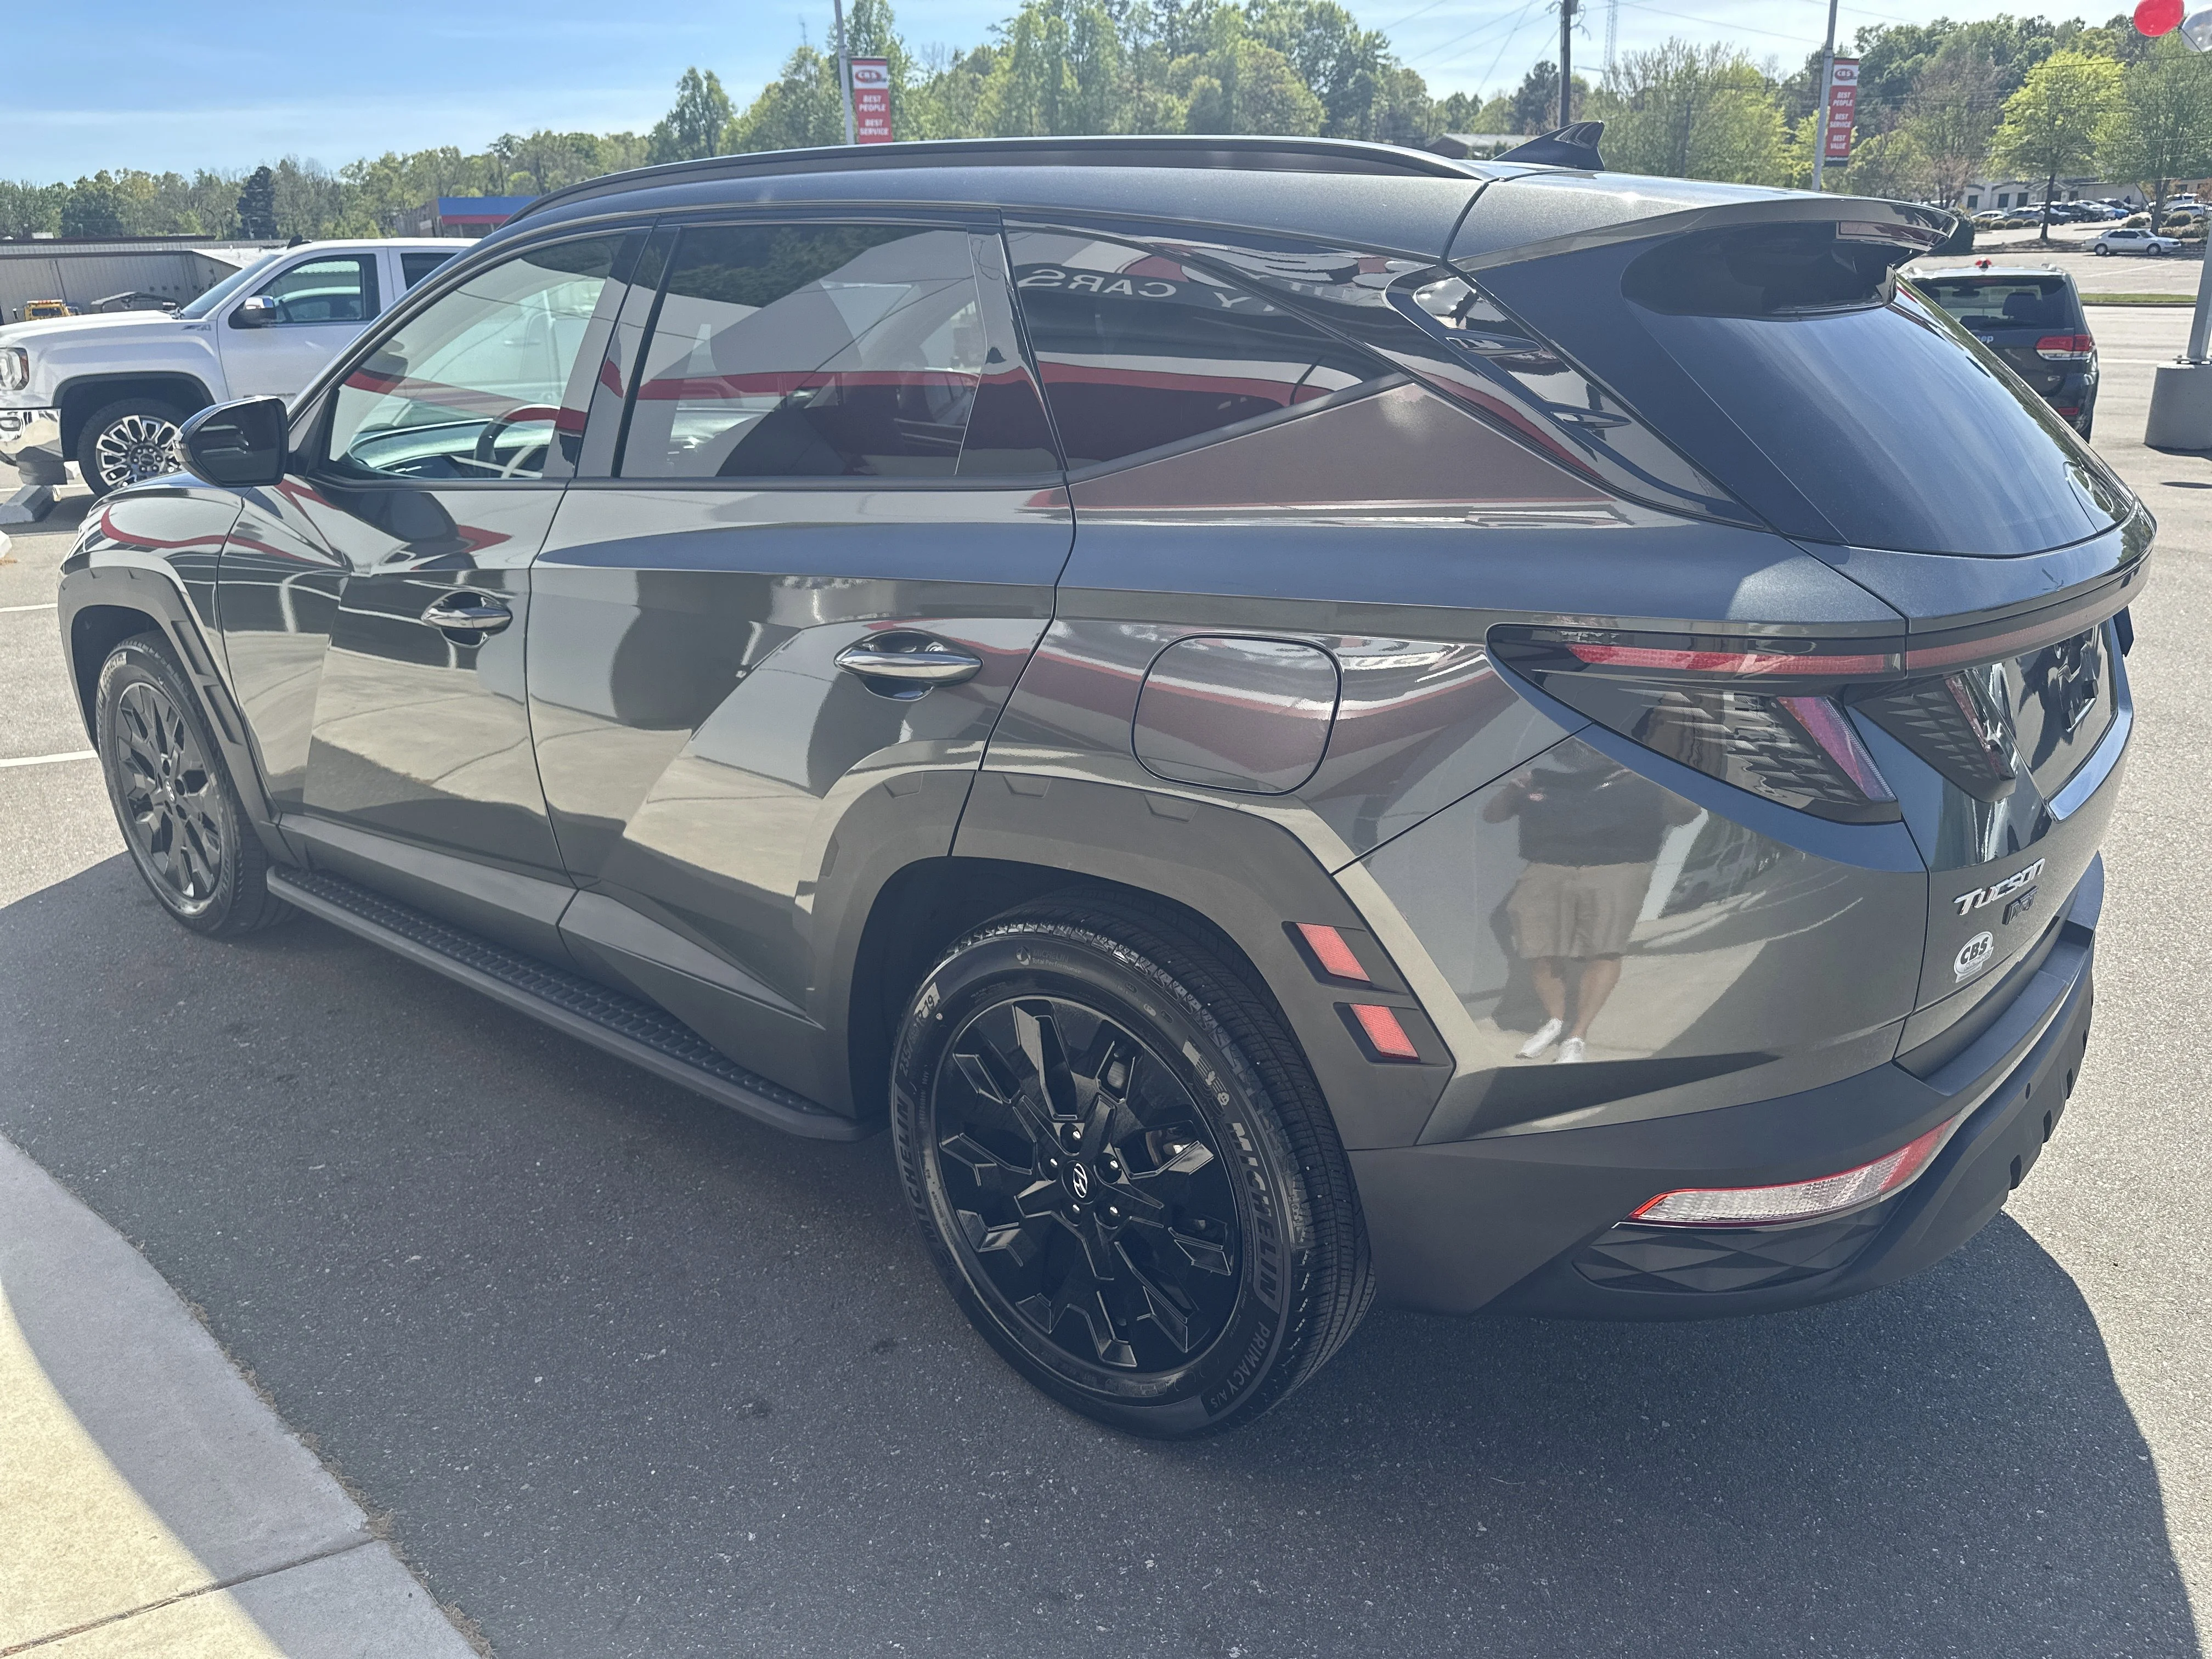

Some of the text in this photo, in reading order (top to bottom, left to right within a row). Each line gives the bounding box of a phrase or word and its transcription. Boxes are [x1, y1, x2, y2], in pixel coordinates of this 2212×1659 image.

[859, 104, 887, 112] PEOPLE
[862, 95, 882, 103] BEST
[860, 127, 889, 136] SERVICE
[865, 119, 884, 127] BEST
[1954, 857, 2046, 916] TUCSON
[1960, 936, 1989, 964] CBS
[896, 1096, 939, 1243] MICHELIN
[1224, 1122, 1277, 1301] MICHELIN
[1210, 1321, 1272, 1408] PRIMACY A/S
